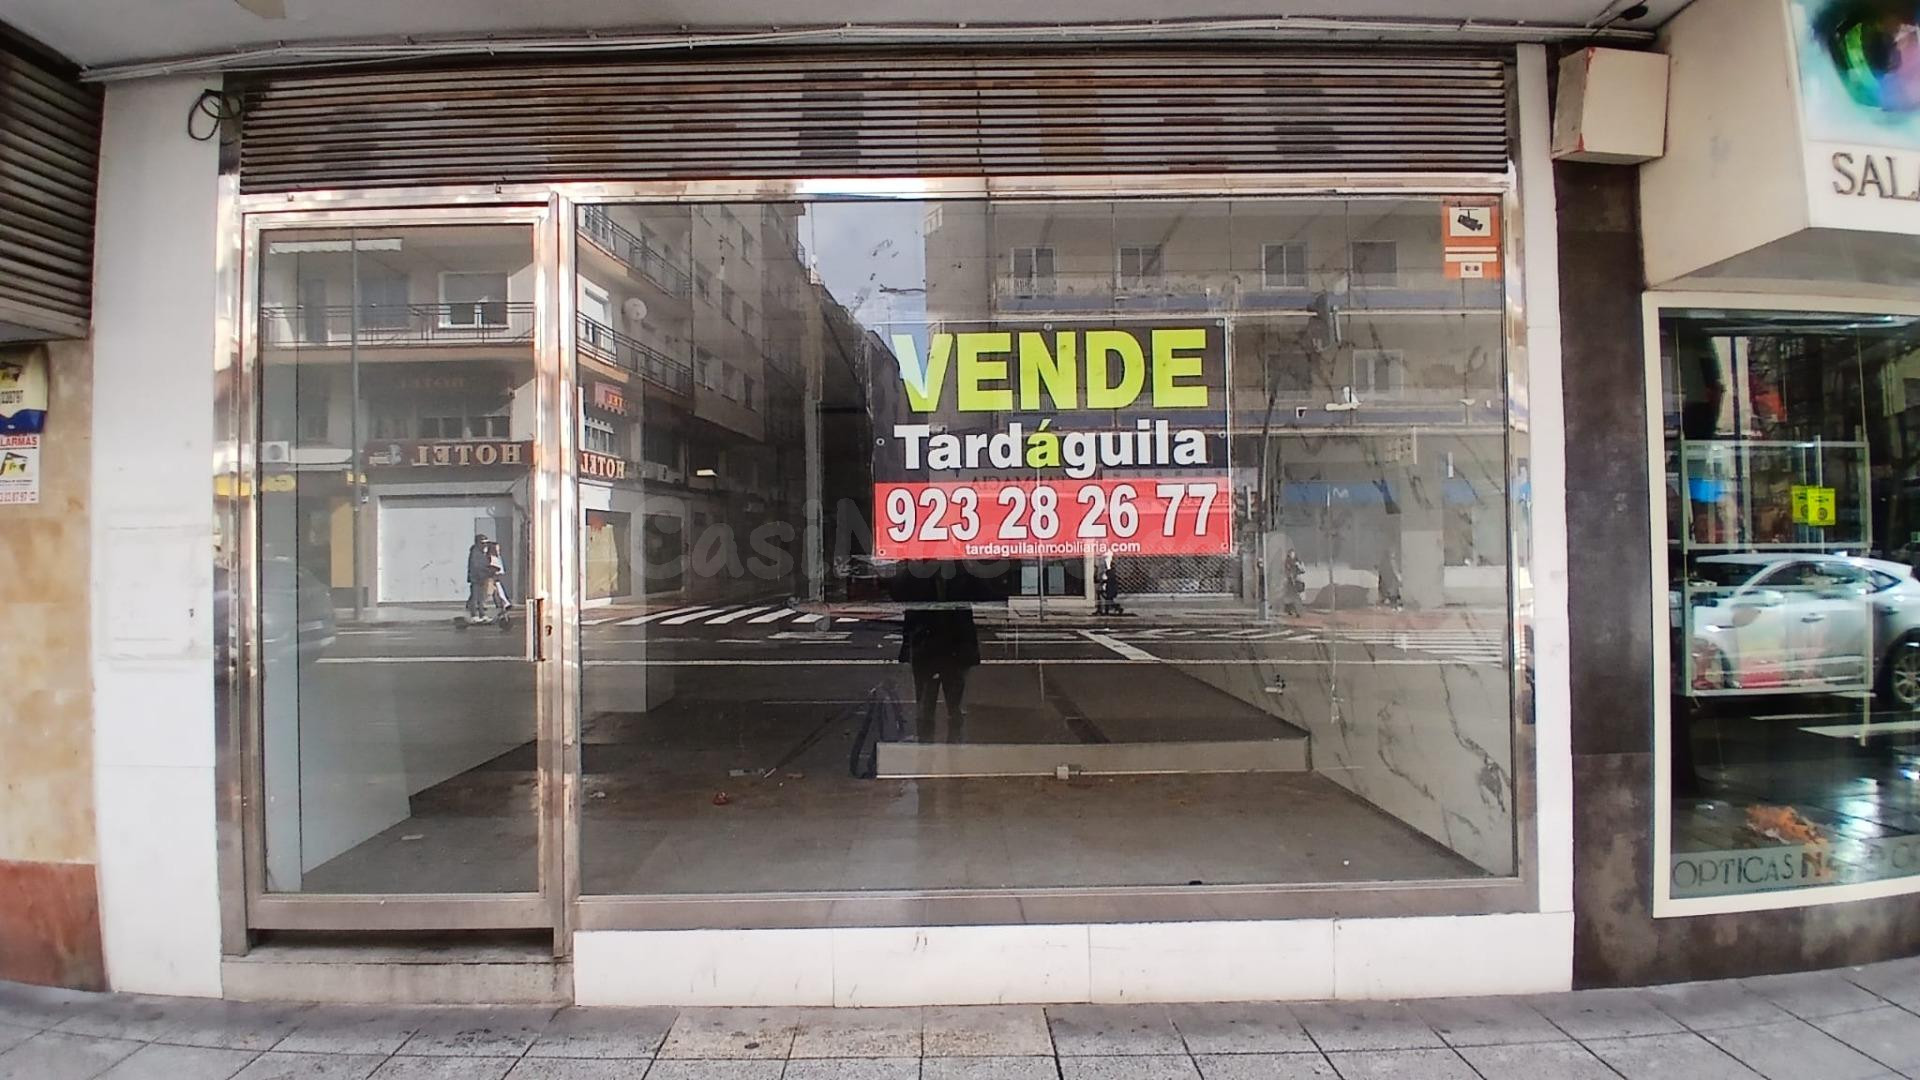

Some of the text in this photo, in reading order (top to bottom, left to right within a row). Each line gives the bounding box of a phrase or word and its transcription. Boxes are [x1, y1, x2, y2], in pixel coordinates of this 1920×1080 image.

[1832, 151, 1920, 202] SAL
[891, 328, 1209, 413] VENDE
[893, 418, 1208, 480] Tardáguila
[886, 482, 1219, 543] 923 28 26 77
[965, 541, 1141, 557] tardaguilainmobiliaria.com
[1672, 853, 1794, 889] OPTICAS
